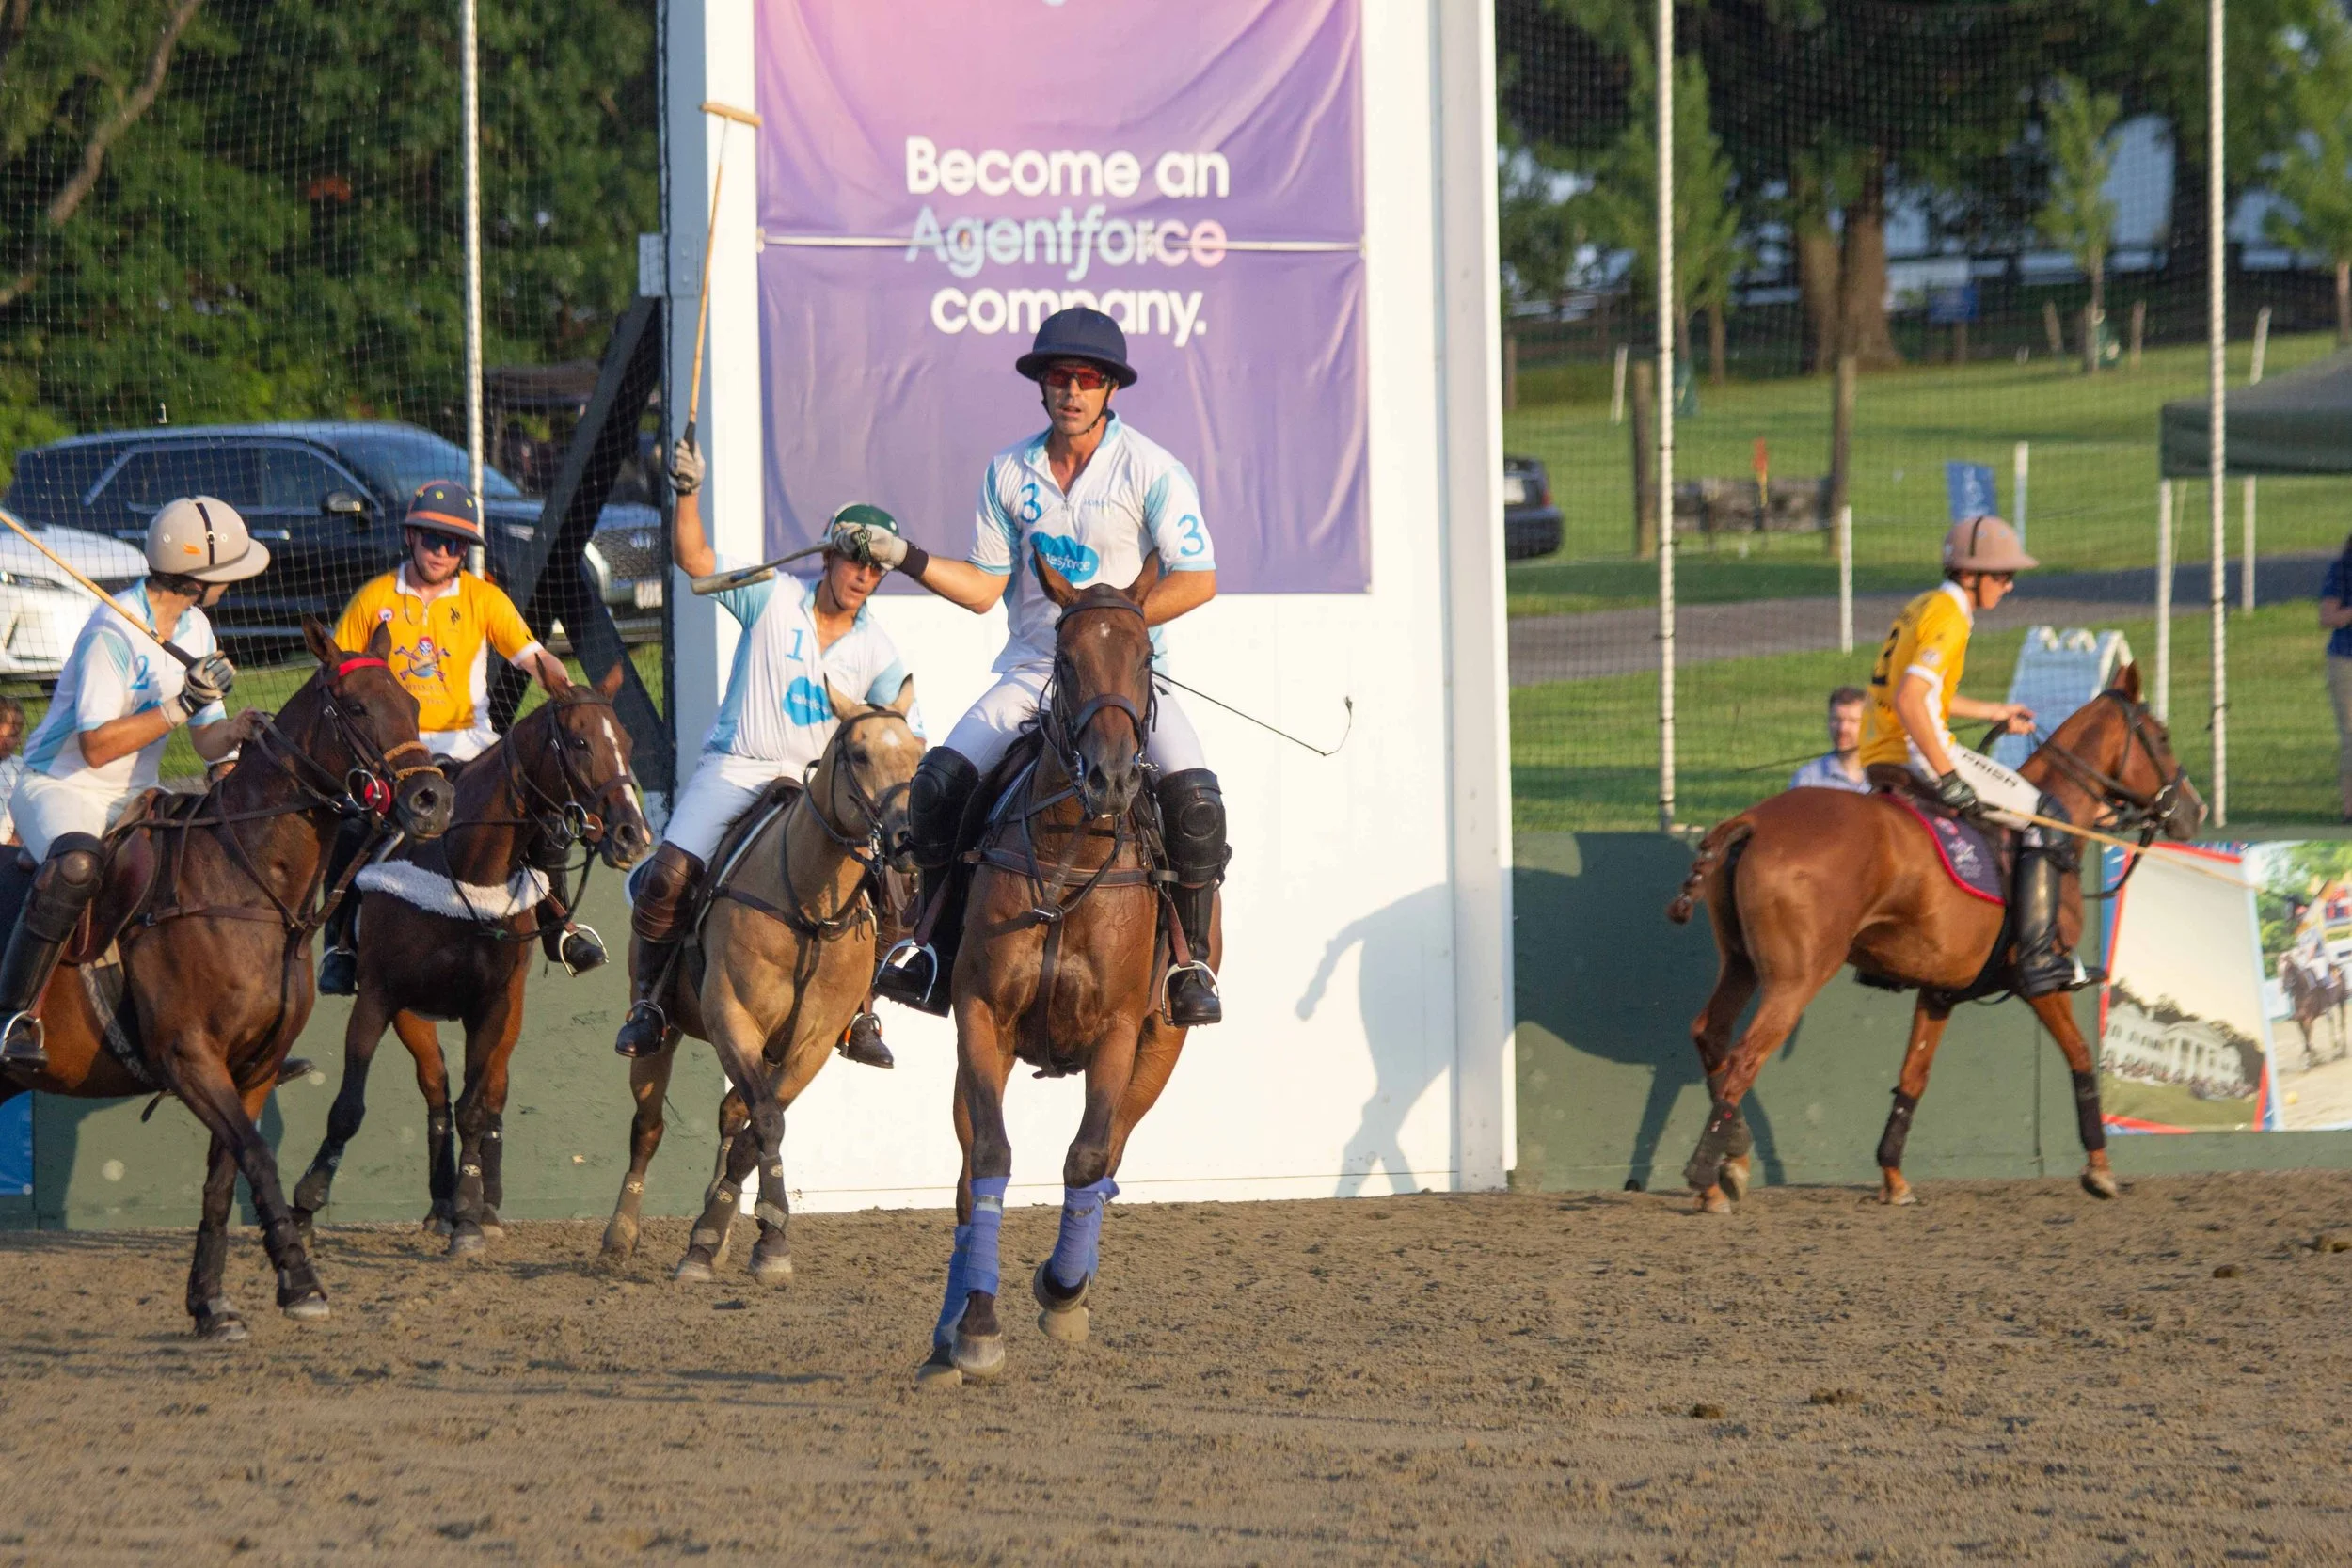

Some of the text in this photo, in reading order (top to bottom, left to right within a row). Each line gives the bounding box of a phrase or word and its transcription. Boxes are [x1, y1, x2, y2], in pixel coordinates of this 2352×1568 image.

[905, 135, 1230, 198] Become an
[904, 203, 1227, 283] Agentforce
[930, 287, 1207, 348] comany.
[1021, 483, 1042, 524] 3
[1177, 514, 1205, 556] 3
[785, 628, 805, 662] 1
[130, 655, 151, 690] 2
